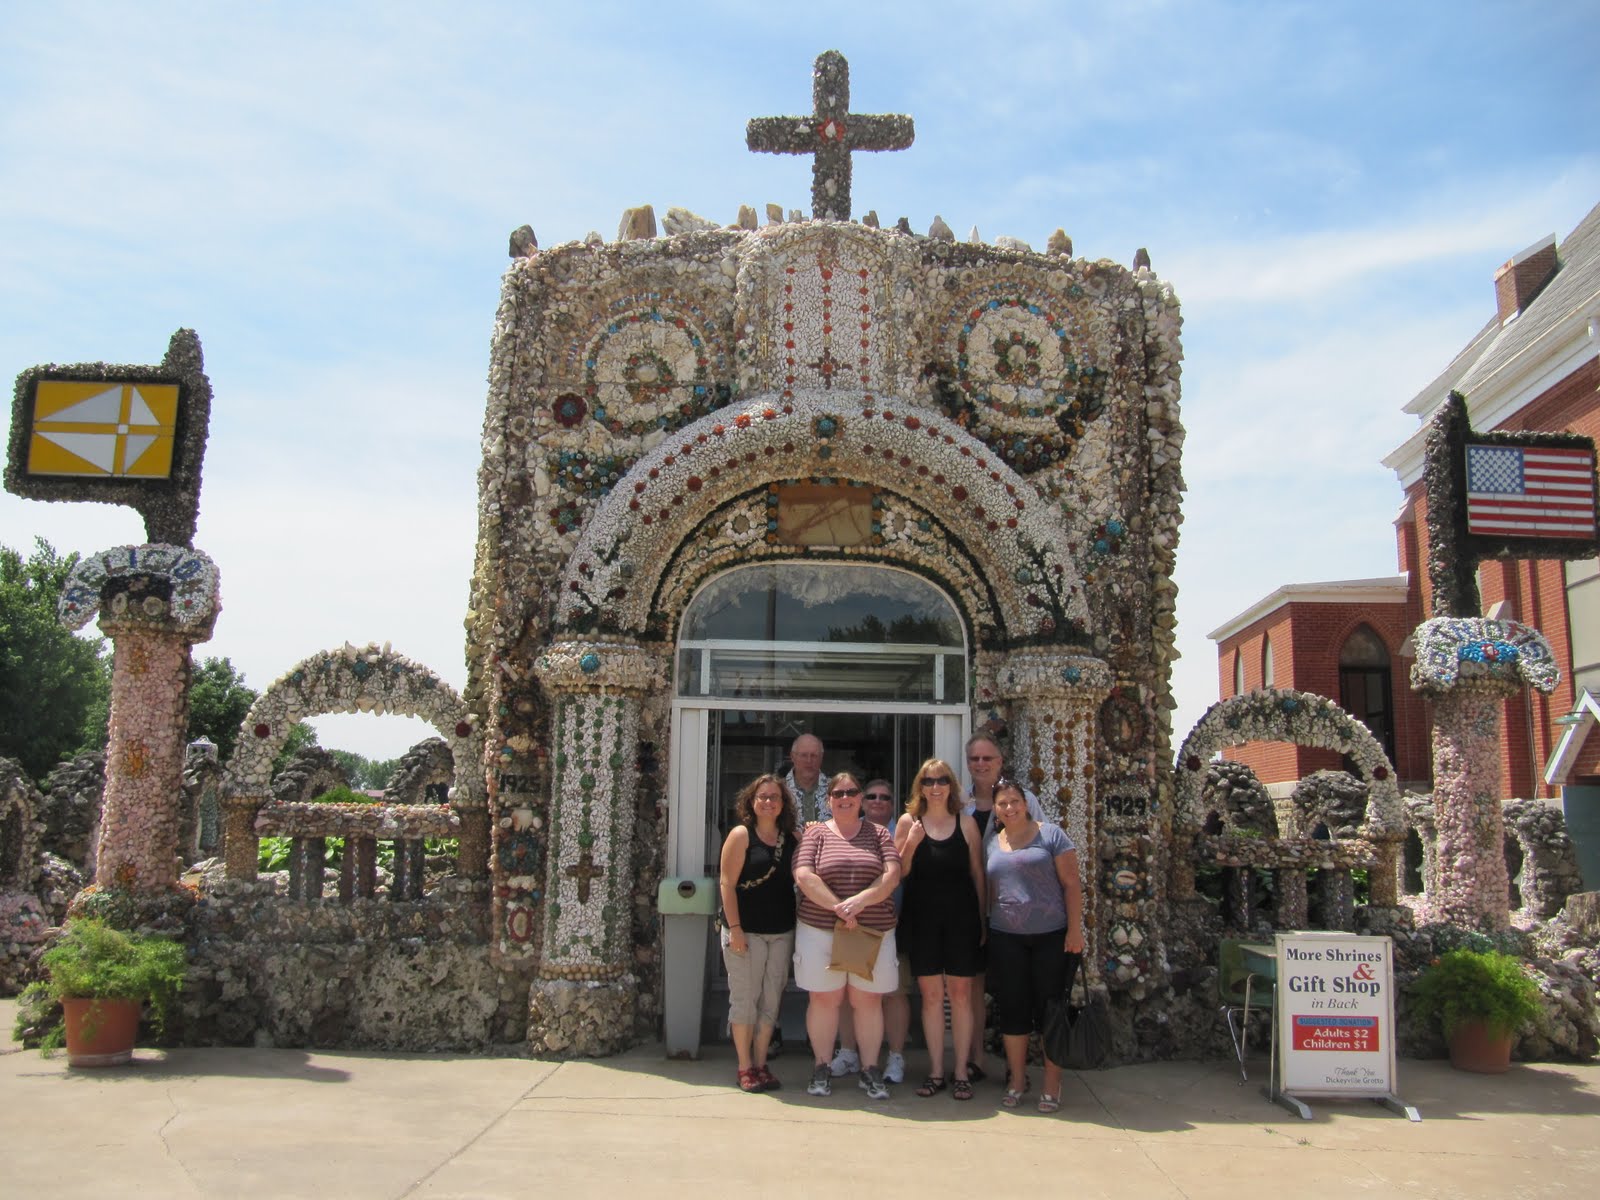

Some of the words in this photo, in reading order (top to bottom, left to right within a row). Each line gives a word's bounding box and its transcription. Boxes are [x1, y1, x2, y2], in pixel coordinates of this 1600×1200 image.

[500, 774, 541, 793] 1925
[1105, 795, 1146, 816] 1929
[1287, 948, 1322, 961] More
[1326, 949, 1382, 962] Shrines
[1352, 963, 1375, 981] &
[1289, 976, 1326, 993] Gift
[1333, 976, 1380, 997] Shop
[1311, 998, 1323, 1009] in
[1327, 998, 1359, 1009] Back
[1339, 1018, 1372, 1027] DONATION
[1313, 1028, 1350, 1038] Adults
[1353, 1029, 1369, 1039] $2
[1303, 1039, 1350, 1049] Children
[1353, 1040, 1367, 1050] $1
[1334, 1067, 1358, 1076] Thank
[1325, 1076, 1361, 1085] Dickeyville
